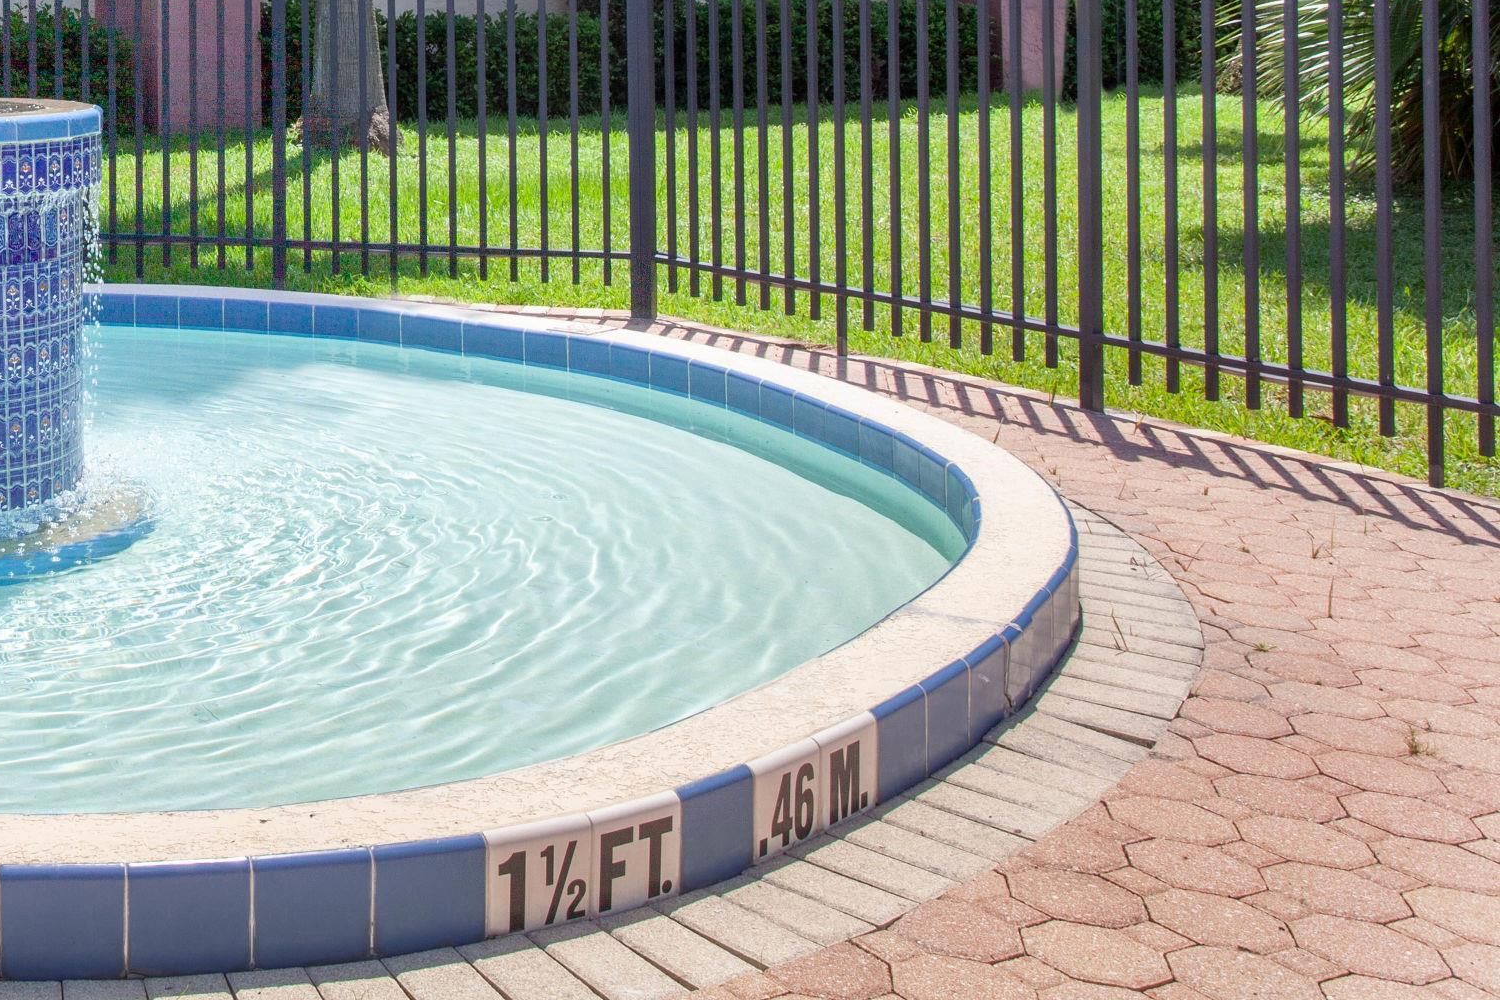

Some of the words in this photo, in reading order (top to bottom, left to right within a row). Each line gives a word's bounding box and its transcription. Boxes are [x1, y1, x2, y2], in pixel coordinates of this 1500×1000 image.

[759, 762, 815, 857] .46
[829, 740, 869, 825] M.
[598, 816, 673, 912] FT.
